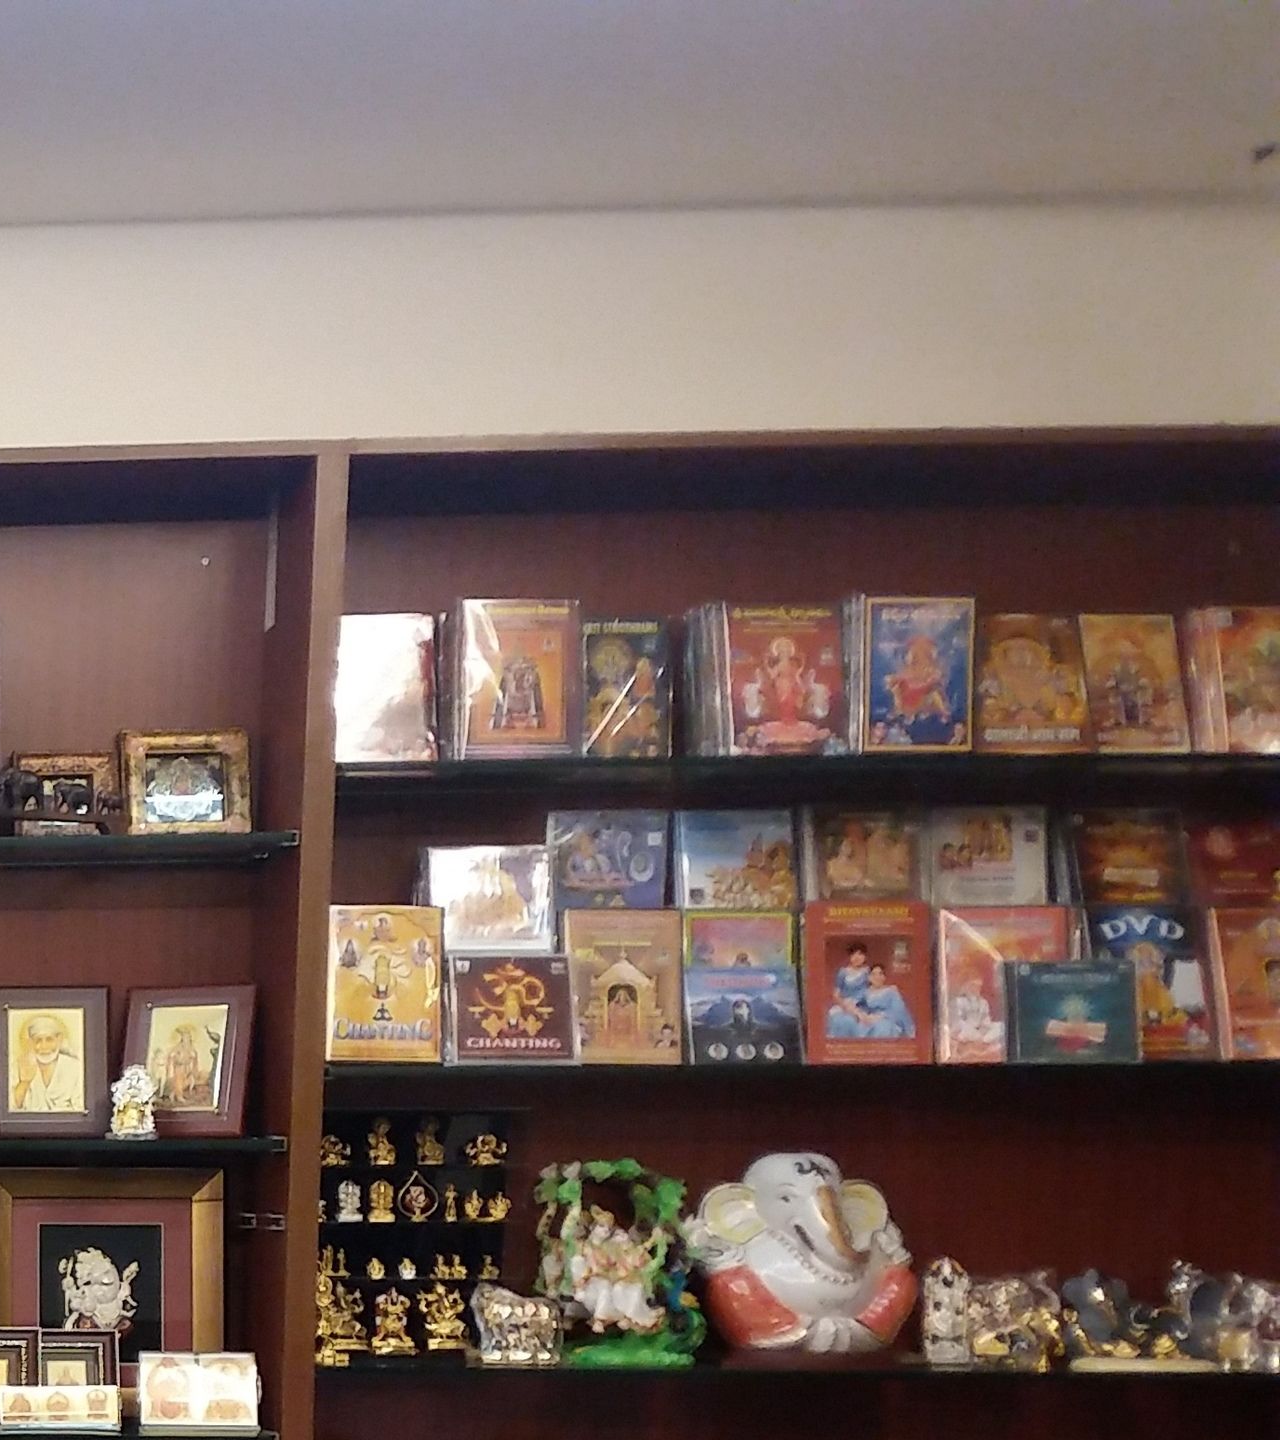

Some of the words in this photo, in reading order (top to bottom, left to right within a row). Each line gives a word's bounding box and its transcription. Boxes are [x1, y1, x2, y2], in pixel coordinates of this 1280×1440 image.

[1099, 913, 1186, 940] DVD
[333, 1017, 433, 1042] CHANTING
[465, 1035, 562, 1050] CHANTING
